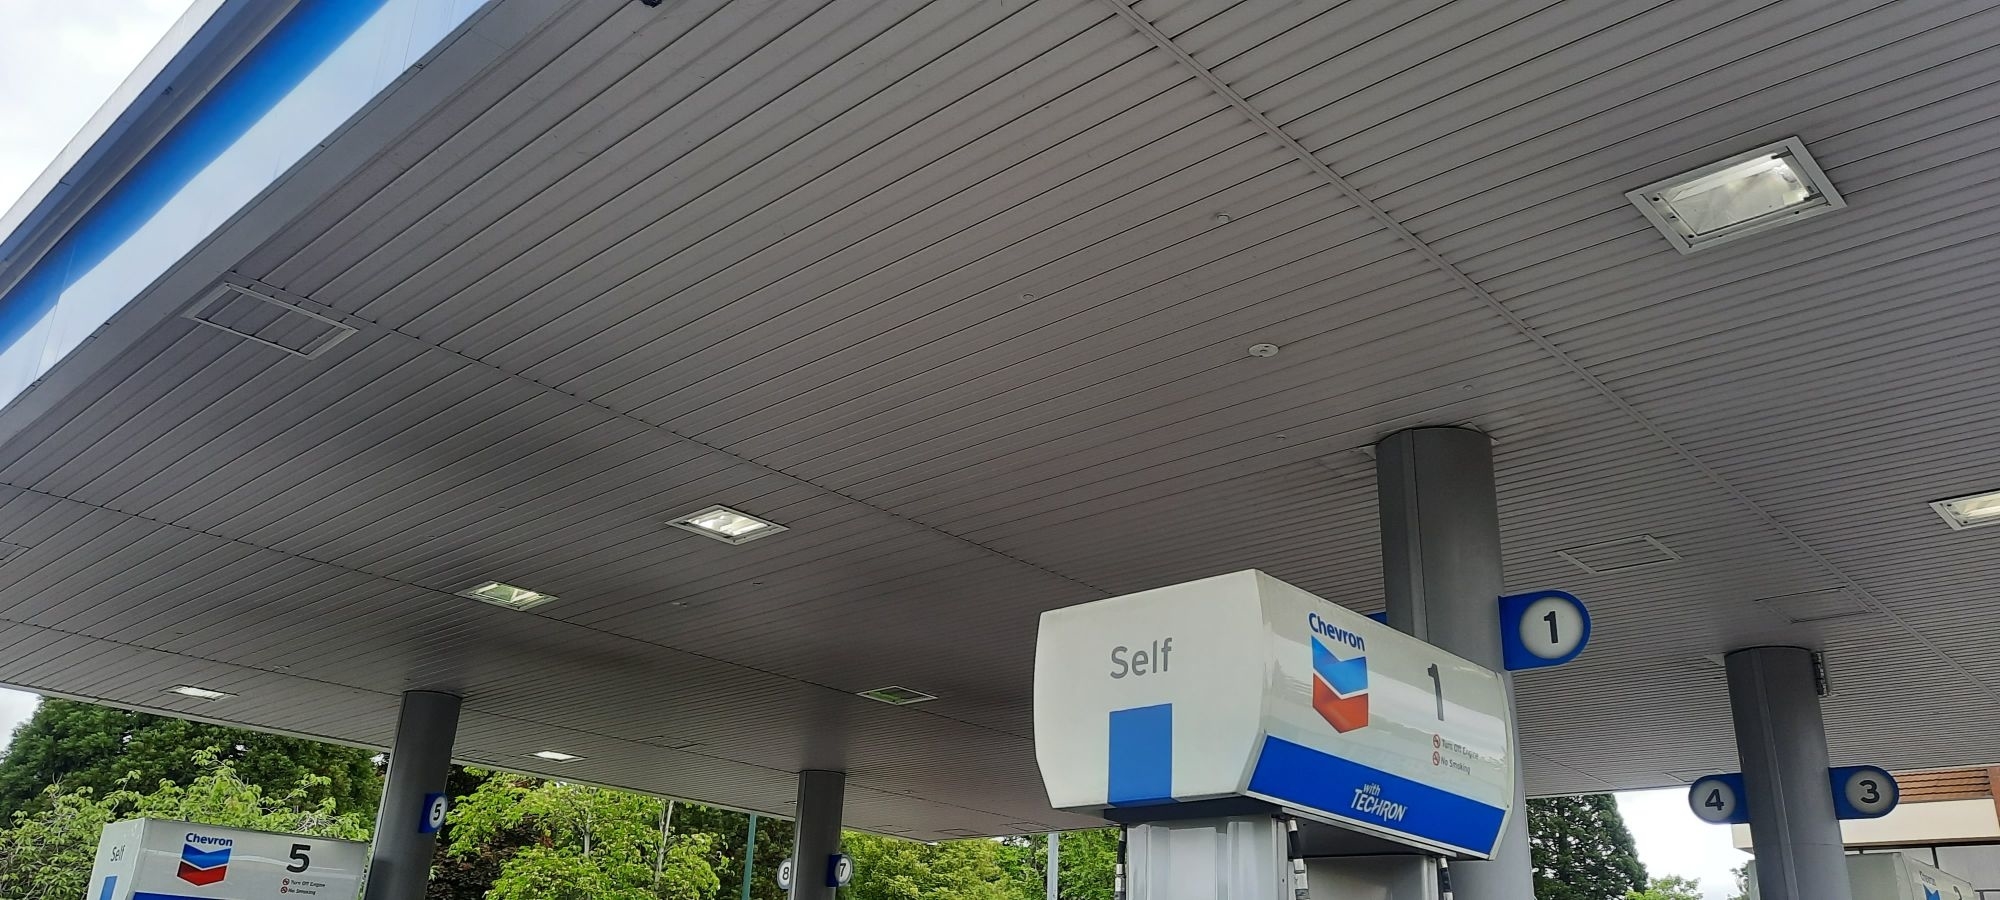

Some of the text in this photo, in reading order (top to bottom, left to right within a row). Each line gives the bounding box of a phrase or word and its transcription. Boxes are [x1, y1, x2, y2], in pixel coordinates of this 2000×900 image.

[1308, 612, 1366, 652] Chevron
[1543, 610, 1559, 644] 1
[1110, 637, 1173, 679] Self
[1427, 662, 1444, 721] 1
[1441, 756, 1471, 775] No Smoking
[1363, 782, 1381, 797] with
[1704, 788, 1724, 811] 4
[1858, 779, 1881, 804] 3
[433, 803, 442, 821] 5
[1350, 788, 1408, 822] TECHRON
[185, 832, 234, 847] Chevron
[110, 844, 126, 862] Self
[286, 843, 311, 873] 5
[782, 867, 789, 880] 8
[840, 863, 846, 877] 7
